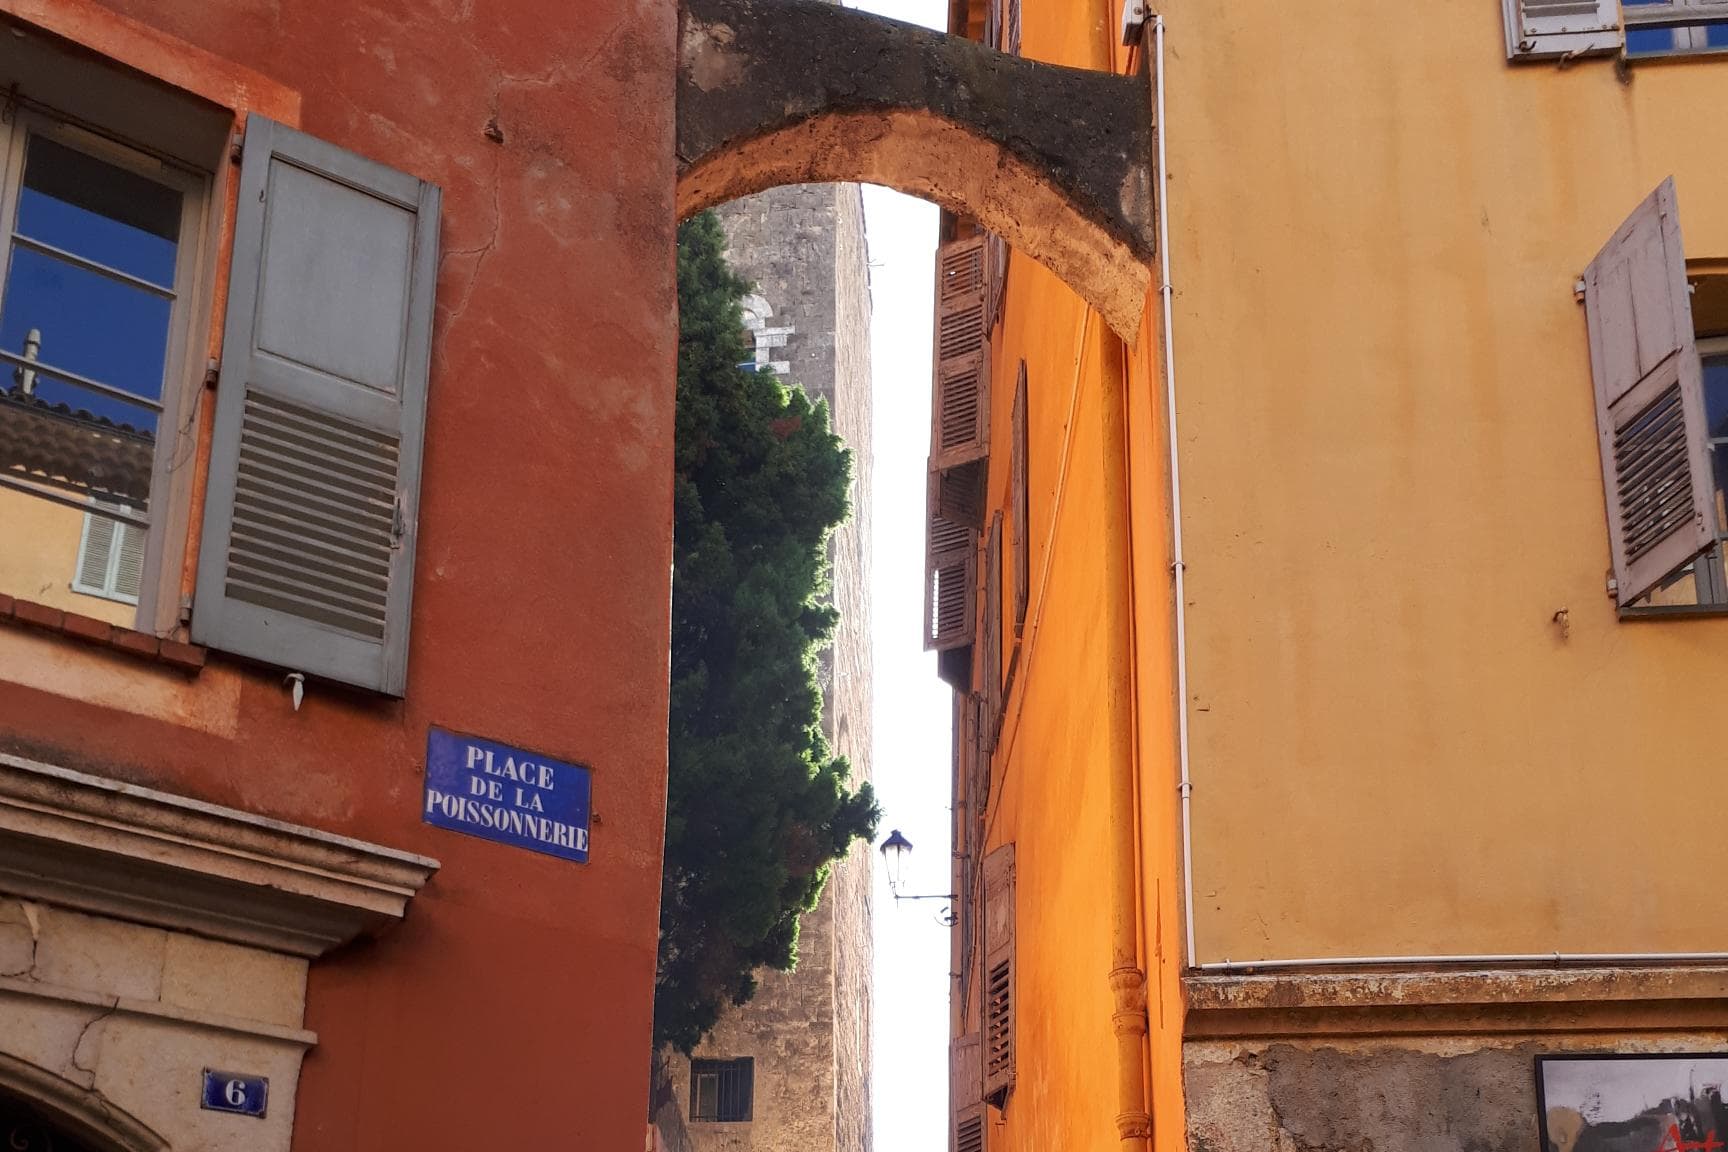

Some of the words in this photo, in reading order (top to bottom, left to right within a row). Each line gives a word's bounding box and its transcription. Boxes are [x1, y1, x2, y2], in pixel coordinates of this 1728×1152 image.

[466, 745, 554, 790] PLACE
[470, 776, 503, 801] DE
[514, 787, 544, 813] LA
[426, 788, 588, 852] POISSONNERIE
[226, 1079, 246, 1106] 6
